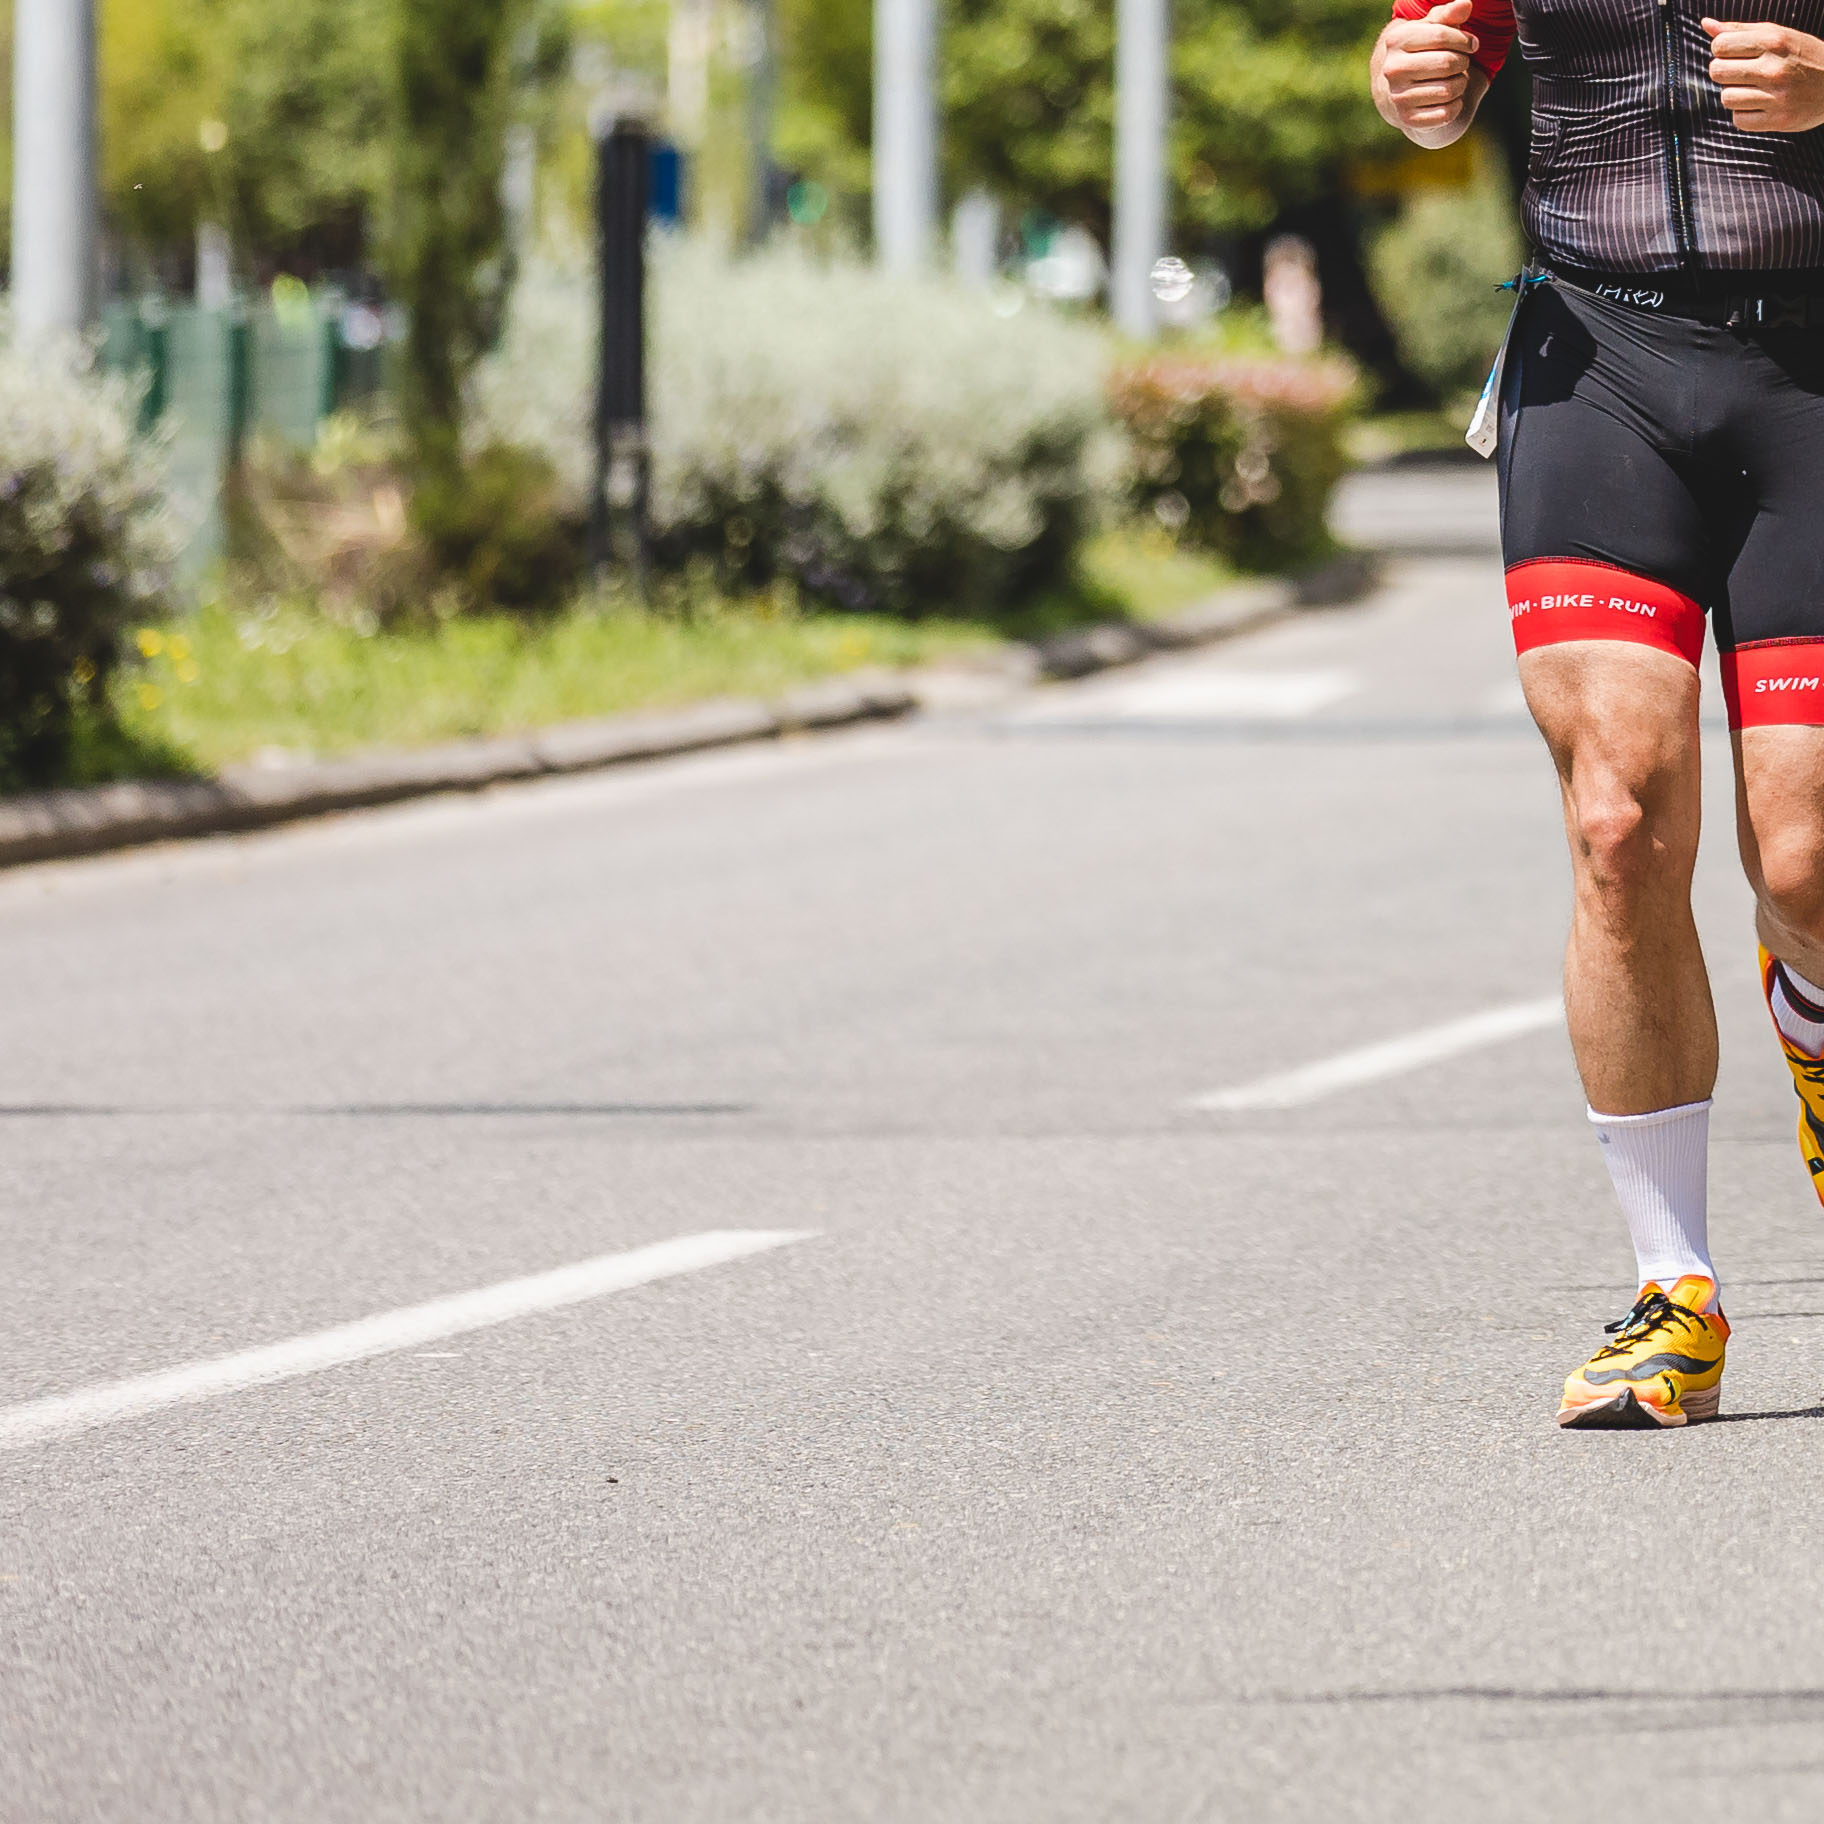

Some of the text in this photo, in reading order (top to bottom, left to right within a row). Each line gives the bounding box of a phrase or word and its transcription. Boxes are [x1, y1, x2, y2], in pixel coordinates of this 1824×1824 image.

[1540, 594, 1595, 610] BIKE
[1607, 597, 1657, 618] RUN
[1754, 677, 1820, 693] SWIM
